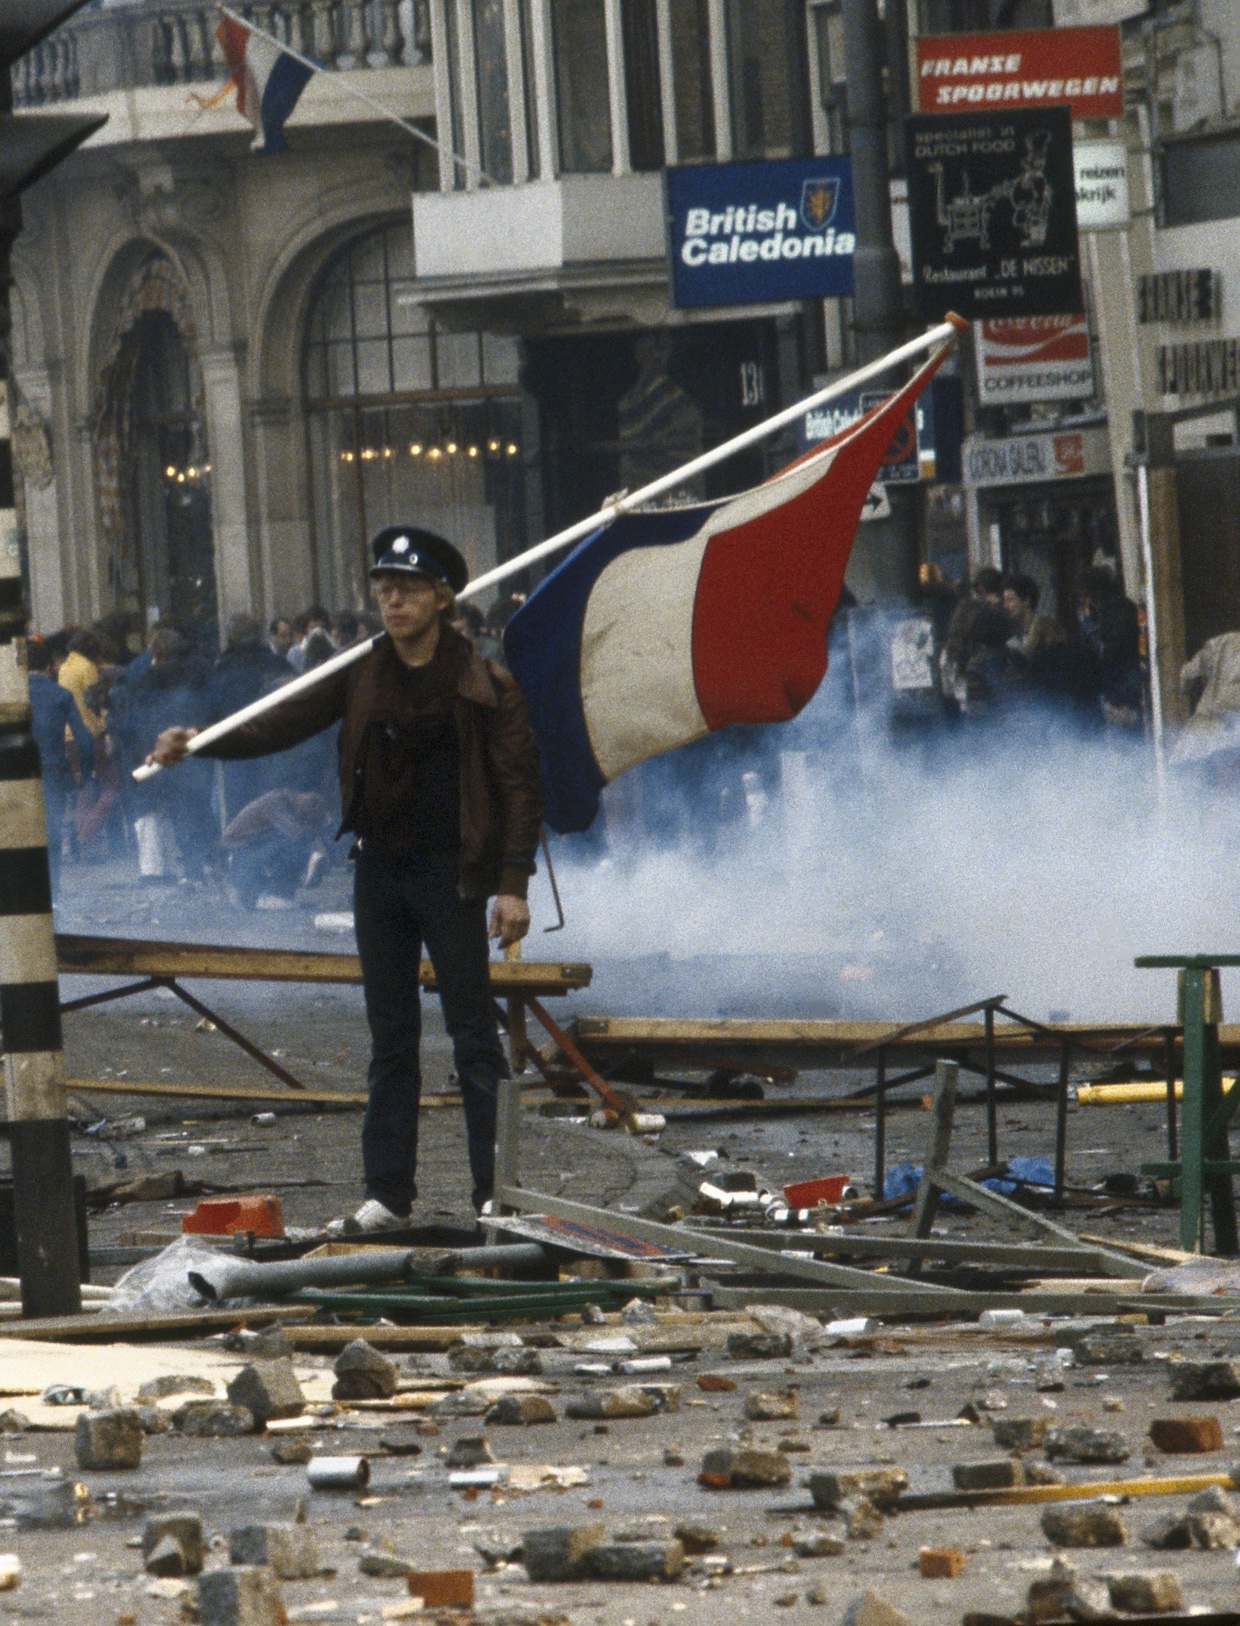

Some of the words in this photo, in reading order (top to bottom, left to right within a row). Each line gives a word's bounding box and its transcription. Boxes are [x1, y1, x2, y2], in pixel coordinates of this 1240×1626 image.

[920, 54, 1023, 77] FRANSE
[936, 76, 1119, 104] SPOORWEGEN
[914, 127, 992, 144] specialist
[1000, 125, 1016, 137] in
[914, 143, 968, 158] DUTCH
[972, 138, 1016, 153] FOOD
[1079, 165, 1126, 180] reizen
[1076, 184, 1117, 205] krijk
[685, 202, 798, 236] British
[922, 264, 987, 284] Restaurant
[985, 369, 1092, 393] COFFEESHOP
